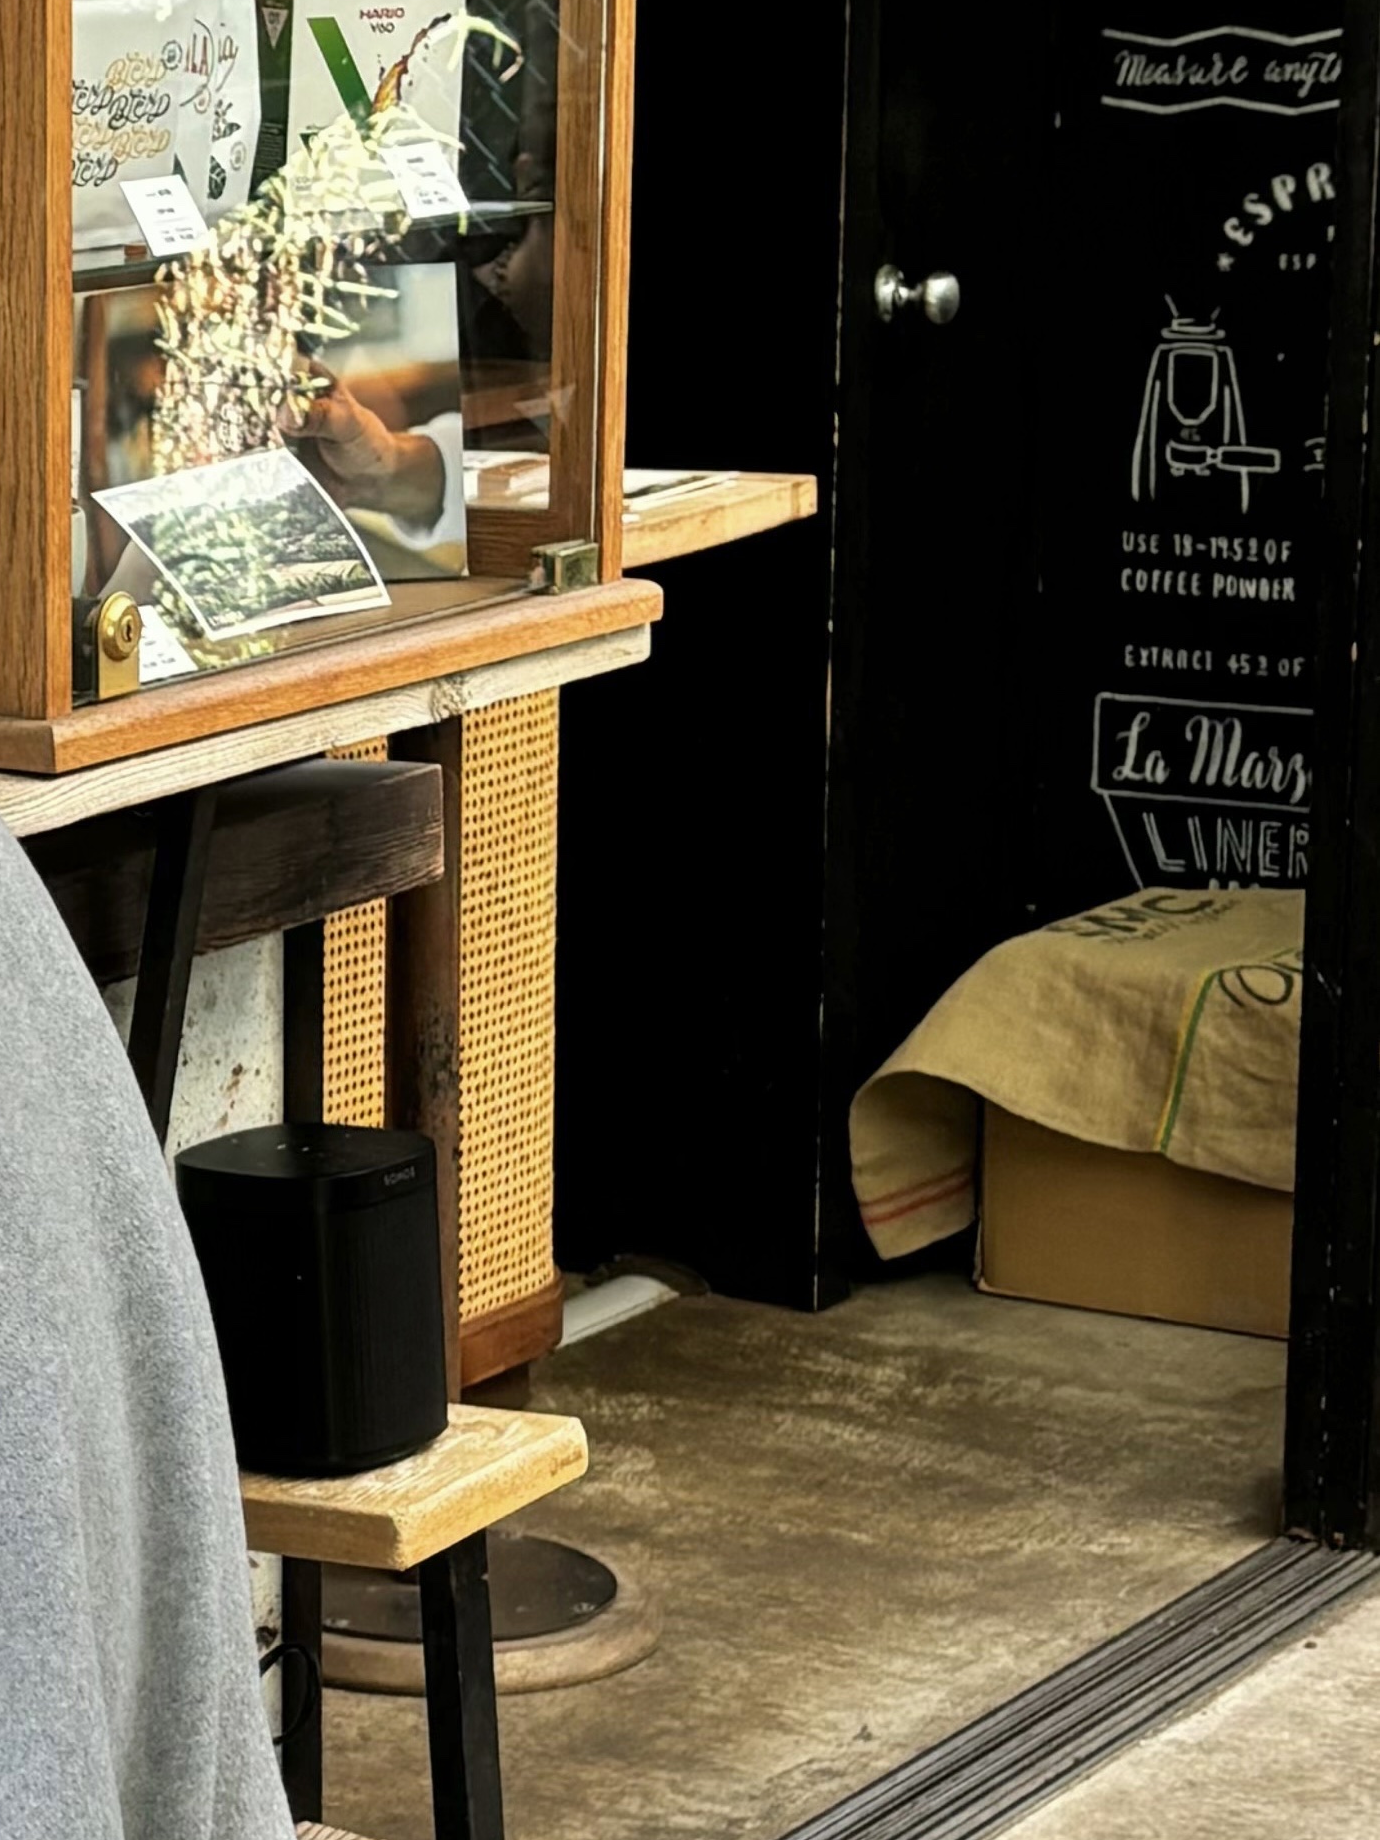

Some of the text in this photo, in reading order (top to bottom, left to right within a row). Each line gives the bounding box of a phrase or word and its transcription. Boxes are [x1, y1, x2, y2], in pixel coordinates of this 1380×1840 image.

[359, 6, 406, 21] HARIO
[1113, 49, 1250, 87] Measure
[1120, 529, 1160, 555] USE
[1263, 537, 1293, 566] OF
[1120, 567, 1296, 603] COFFEE POWDER
[1123, 643, 1213, 672] EXTRACT
[1277, 656, 1306, 678] OF
[1111, 711, 1312, 806] La Marz
